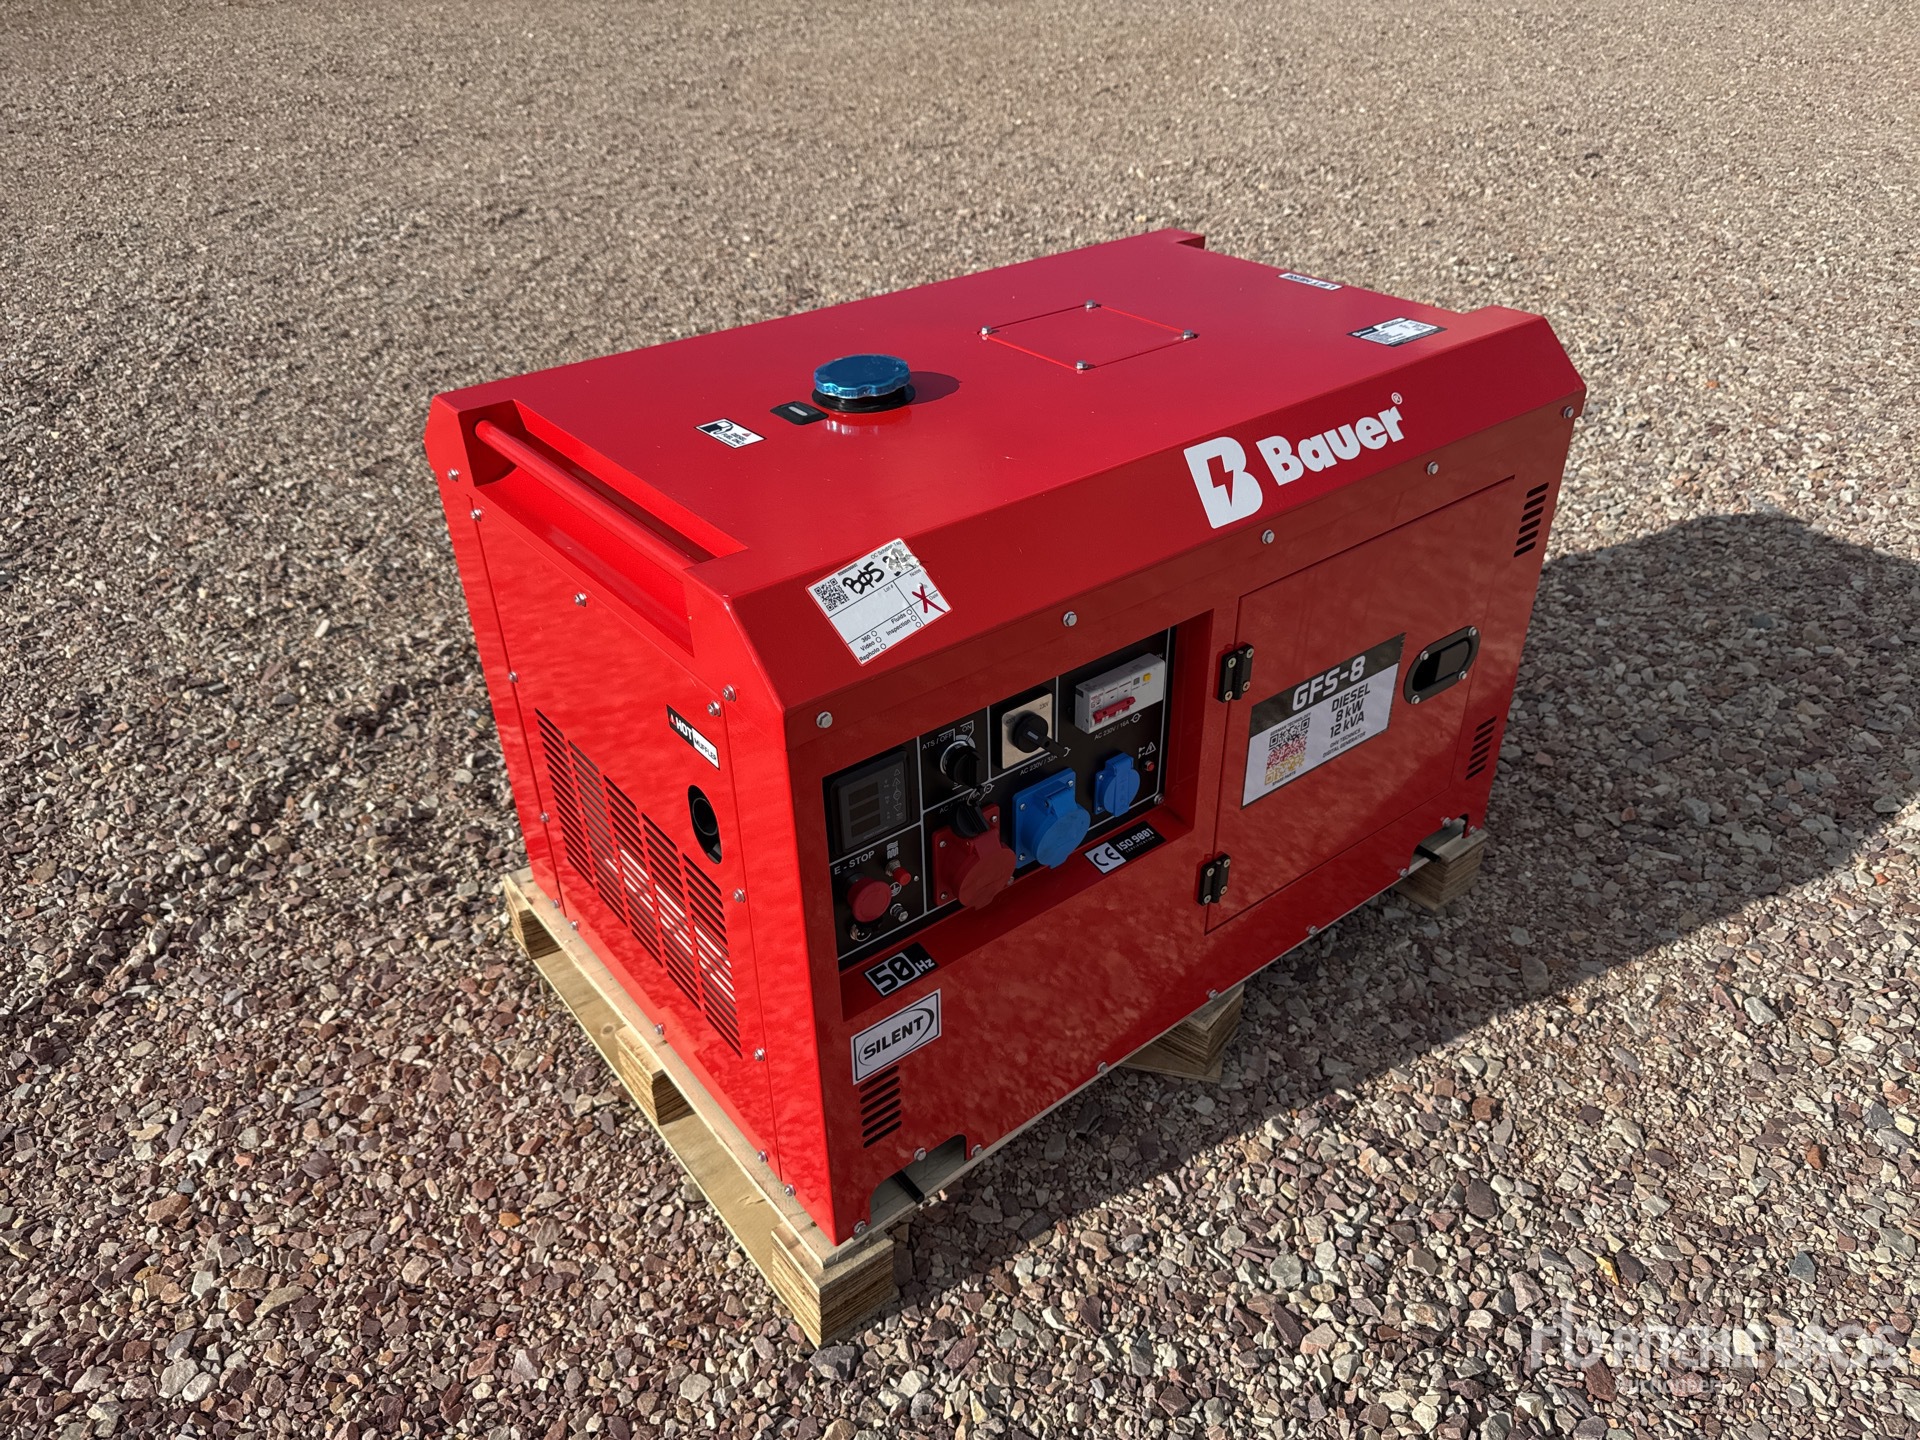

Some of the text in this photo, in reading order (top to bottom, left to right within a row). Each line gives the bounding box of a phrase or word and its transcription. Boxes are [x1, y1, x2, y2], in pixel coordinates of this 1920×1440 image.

[1256, 405, 1405, 487] Bauer
[885, 619, 911, 636] Inspection
[890, 613, 907, 624] Fluids
[859, 641, 875, 651] Video
[861, 634, 872, 643] 360
[1292, 655, 1366, 711] GFS-8
[1331, 683, 1371, 712] DIESEL
[1335, 698, 1364, 722] 8 kW
[675, 717, 693, 740] HOT
[961, 724, 972, 733] ON
[1103, 725, 1117, 737] 230V
[1329, 711, 1365, 739] 12 kVA
[921, 739, 936, 751] ATS
[939, 732, 953, 744] OFF
[1339, 731, 1366, 749] GENERATOR
[1019, 767, 1029, 777] AC
[1029, 761, 1044, 773] 230V
[833, 865, 841, 876] E
[849, 849, 875, 869] STOP
[1093, 846, 1121, 866] CE
[1115, 840, 1134, 851] ISO
[869, 955, 936, 994] 50 Hz
[863, 1015, 924, 1061] SILENT
